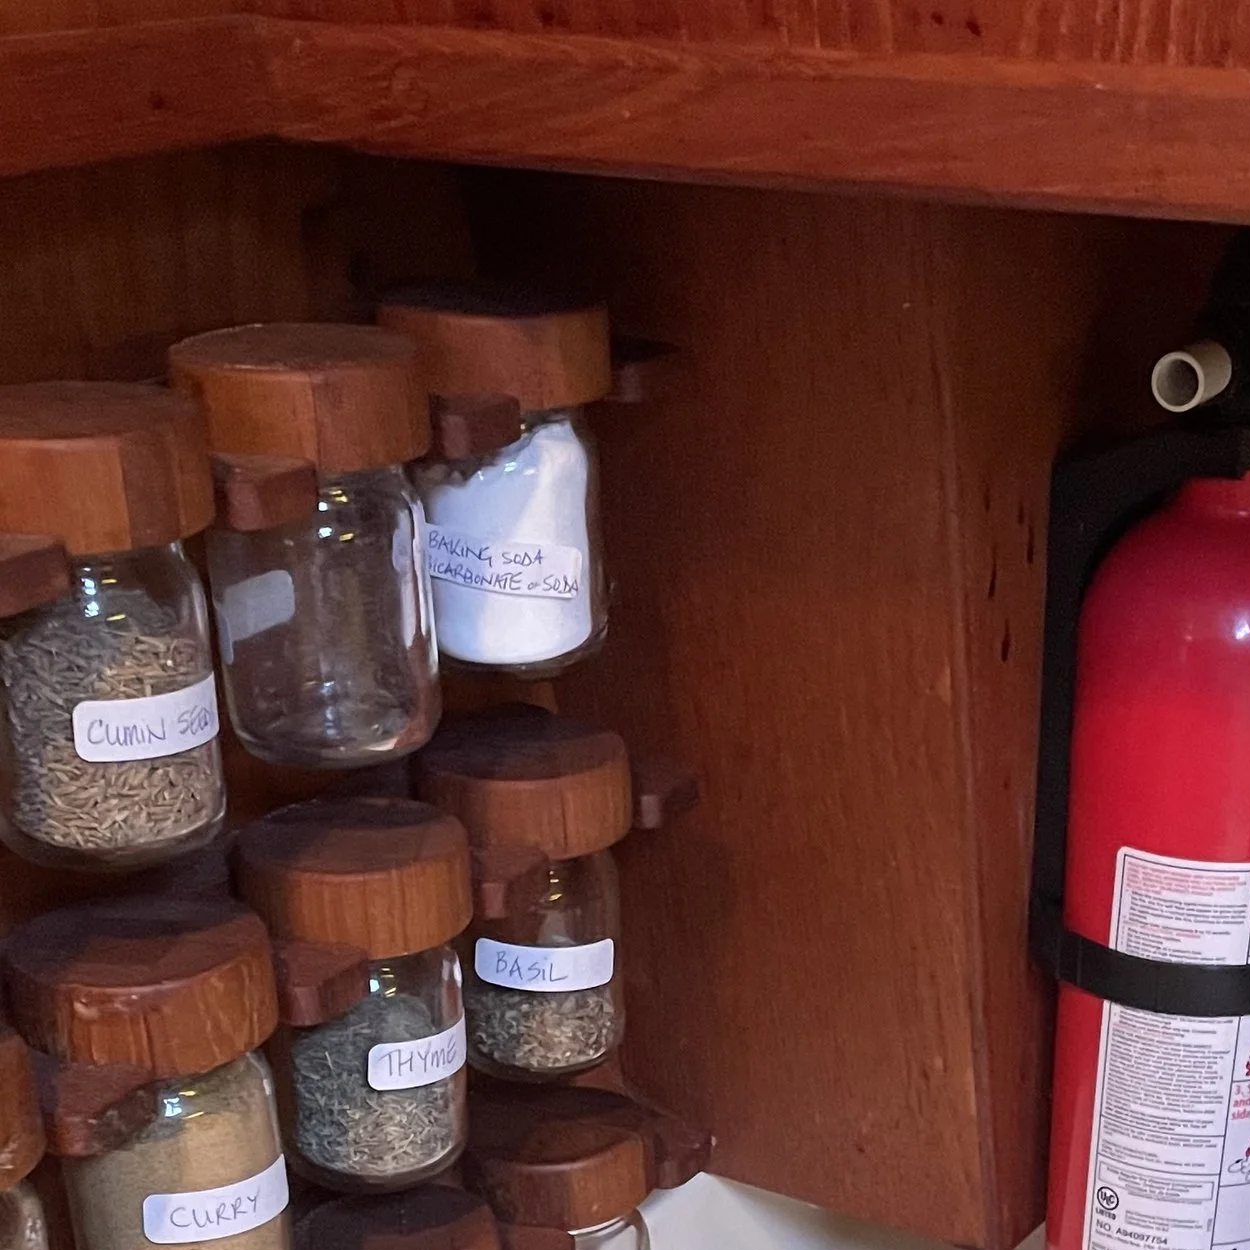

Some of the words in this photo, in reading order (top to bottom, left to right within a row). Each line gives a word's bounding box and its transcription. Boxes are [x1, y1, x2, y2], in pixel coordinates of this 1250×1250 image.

[428, 530, 492, 567] BAKING
[501, 549, 544, 567] SODA
[542, 573, 579, 594] SODA
[170, 1185, 261, 1228] CURRY
